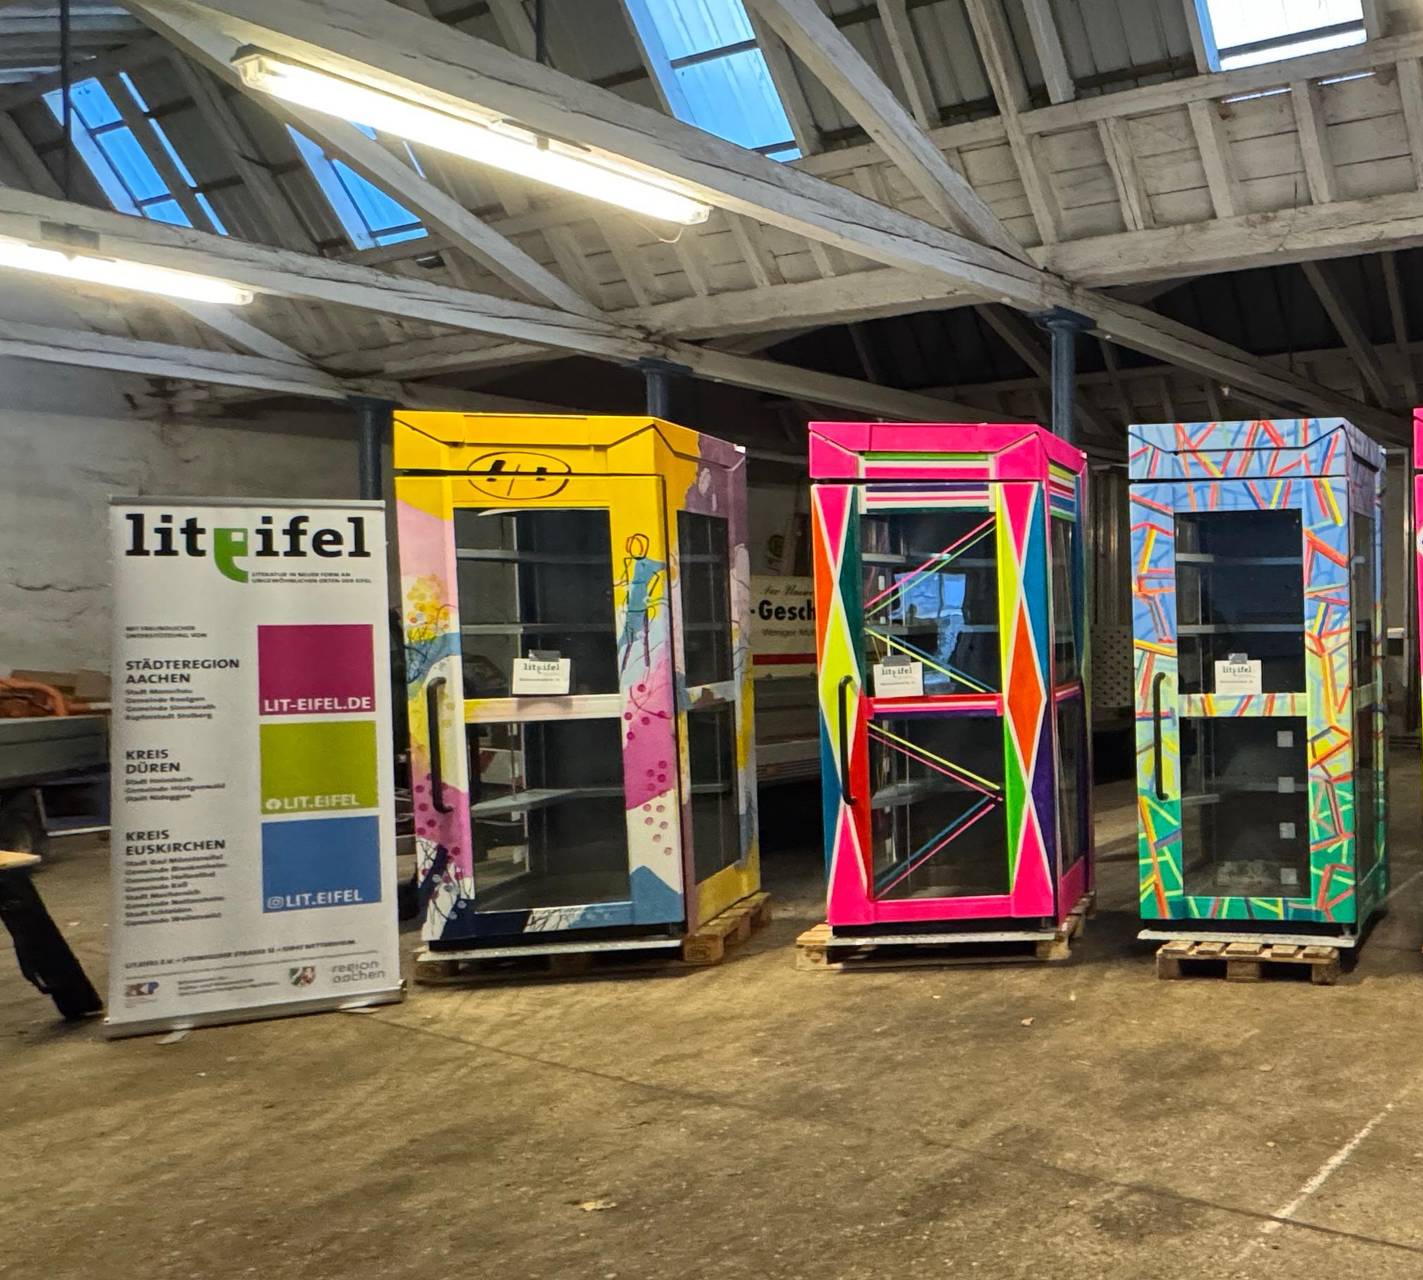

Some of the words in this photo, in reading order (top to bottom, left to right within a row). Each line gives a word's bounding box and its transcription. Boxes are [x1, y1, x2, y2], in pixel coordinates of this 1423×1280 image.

[126, 658, 240, 671] STÄDTEREGION
[126, 673, 191, 684] AACHEN
[264, 696, 371, 712] LIT-EIFEL.DE
[126, 749, 169, 760] KREIS
[126, 761, 180, 774] DÜREN
[283, 793, 360, 810] LIT.EIFEL
[126, 829, 170, 841] KREIS
[126, 840, 226, 856] EUSKIRCHEN
[286, 889, 363, 908] LIT.EIFEL
